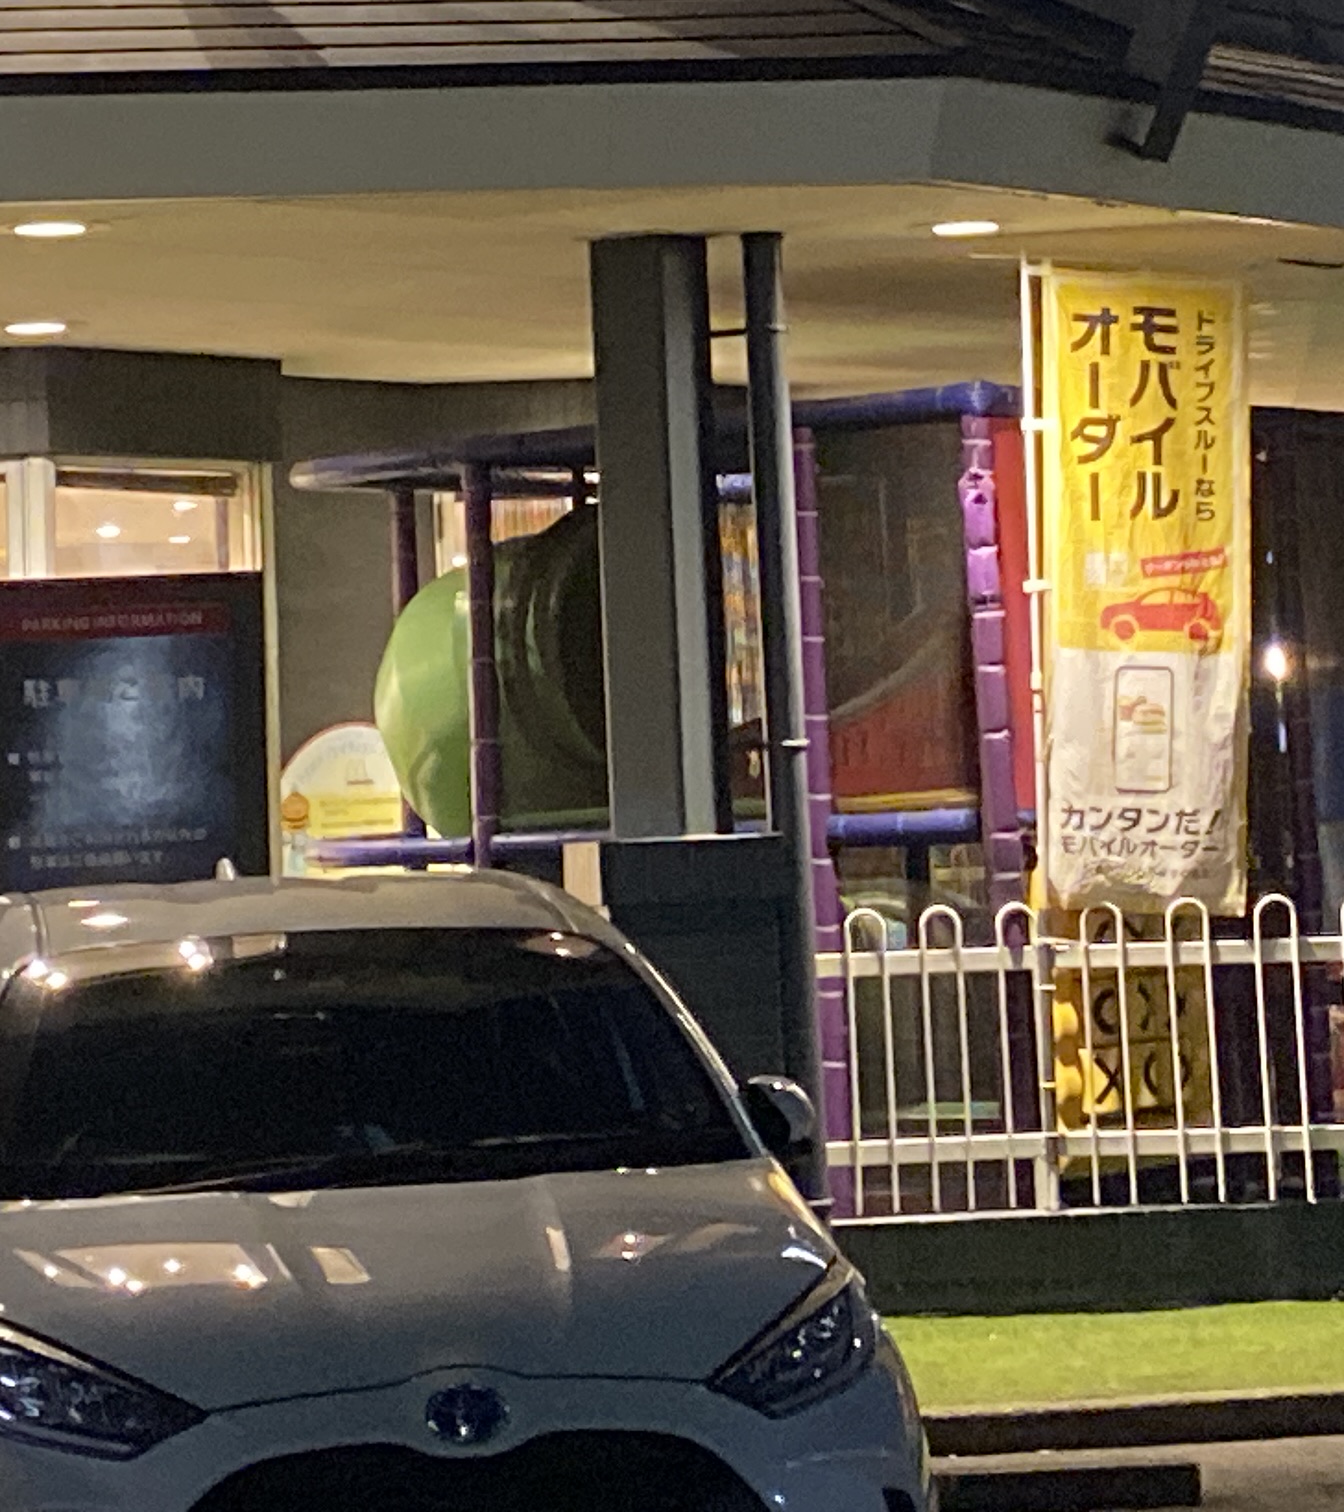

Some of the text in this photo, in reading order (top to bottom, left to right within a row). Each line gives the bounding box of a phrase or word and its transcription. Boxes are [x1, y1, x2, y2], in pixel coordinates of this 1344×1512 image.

[1070, 307, 1122, 521] オーダー
[1129, 305, 1180, 521] モバイル
